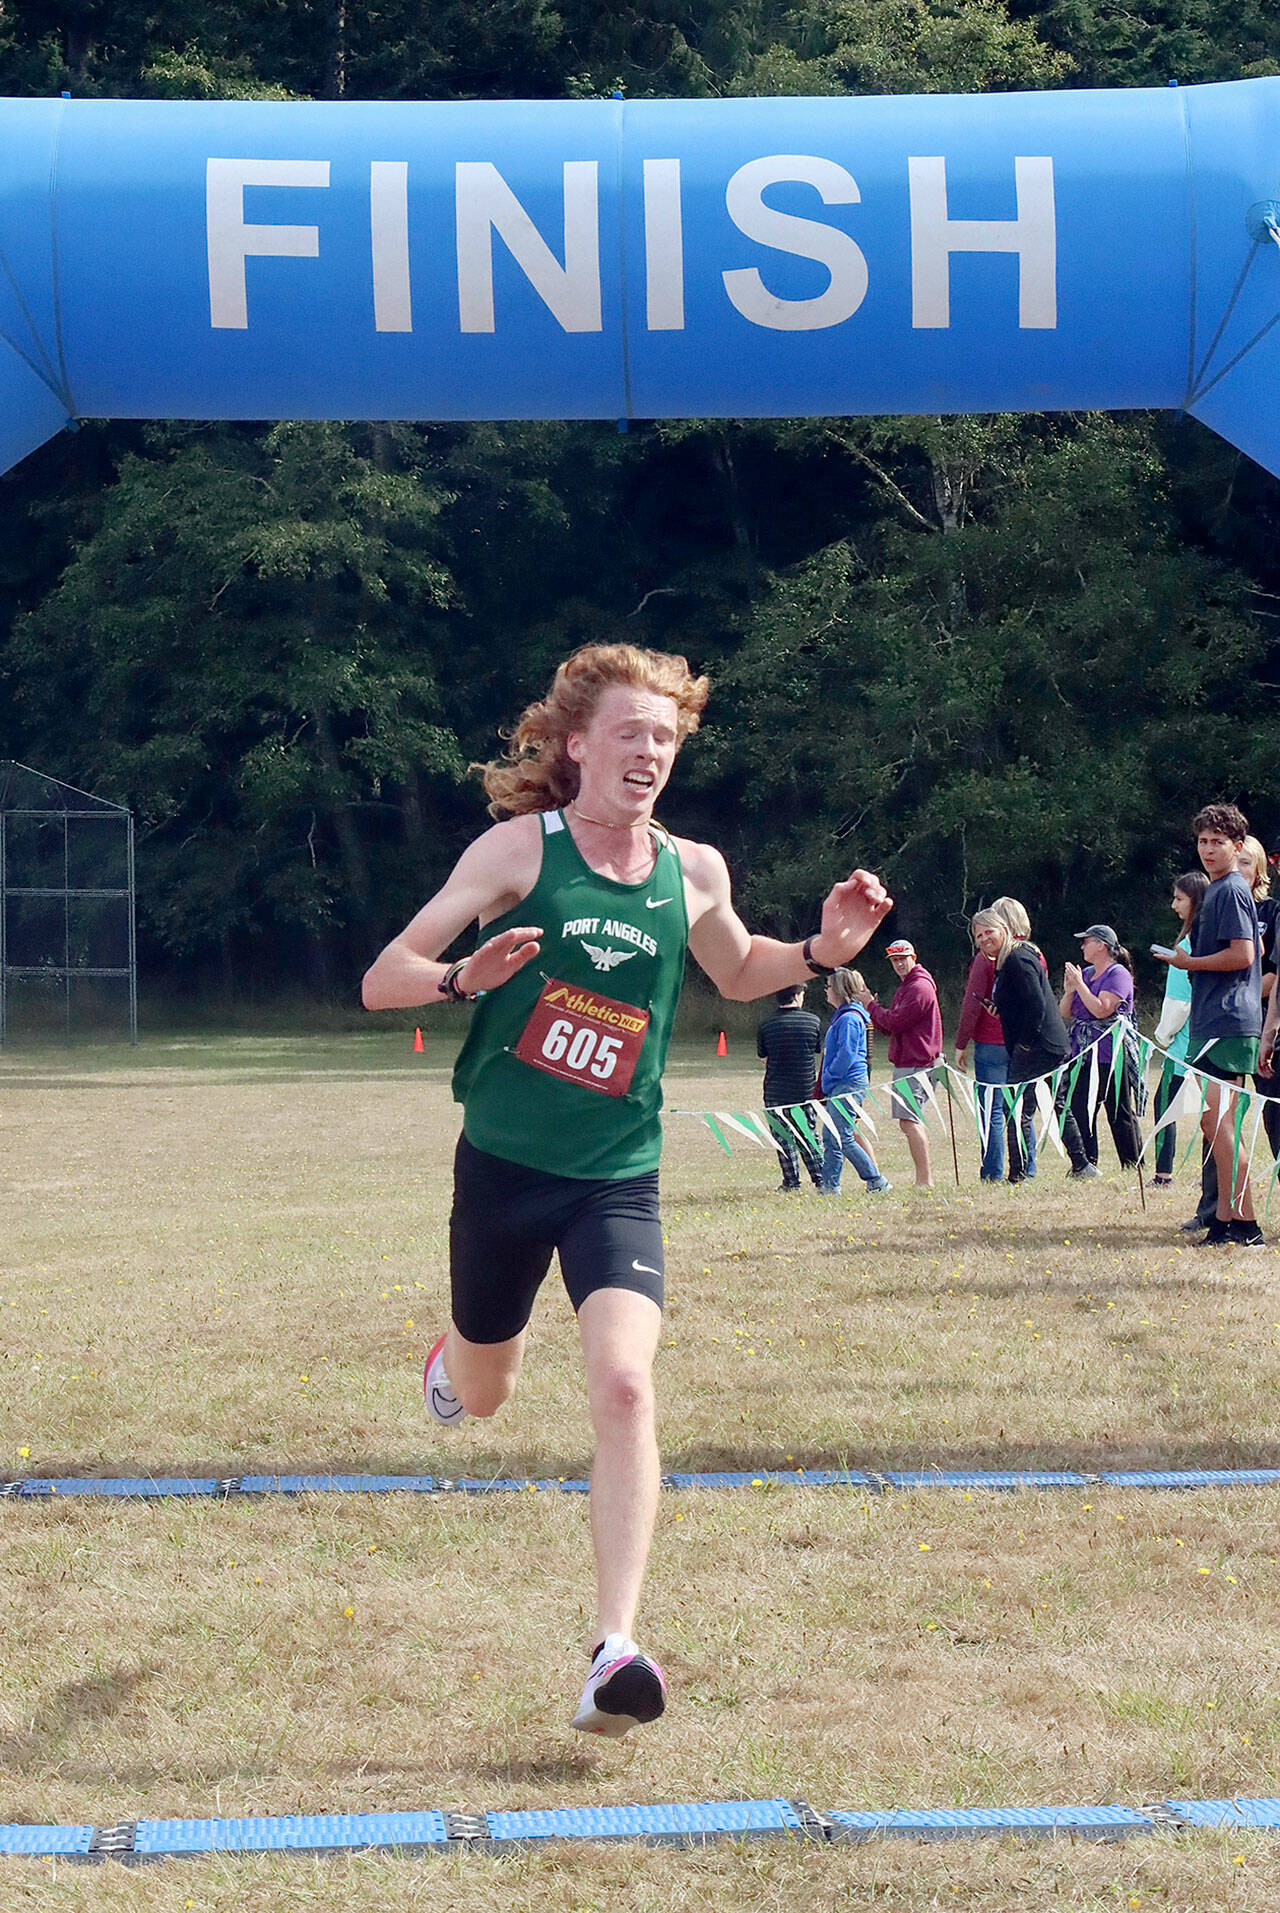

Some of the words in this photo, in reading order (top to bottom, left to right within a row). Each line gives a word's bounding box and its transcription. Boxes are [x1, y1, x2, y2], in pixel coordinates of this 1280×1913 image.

[206, 154, 1057, 333] FINISH
[561, 918, 601, 938] PORT
[601, 919, 658, 957] ANGELES
[541, 1019, 624, 1079] 605
